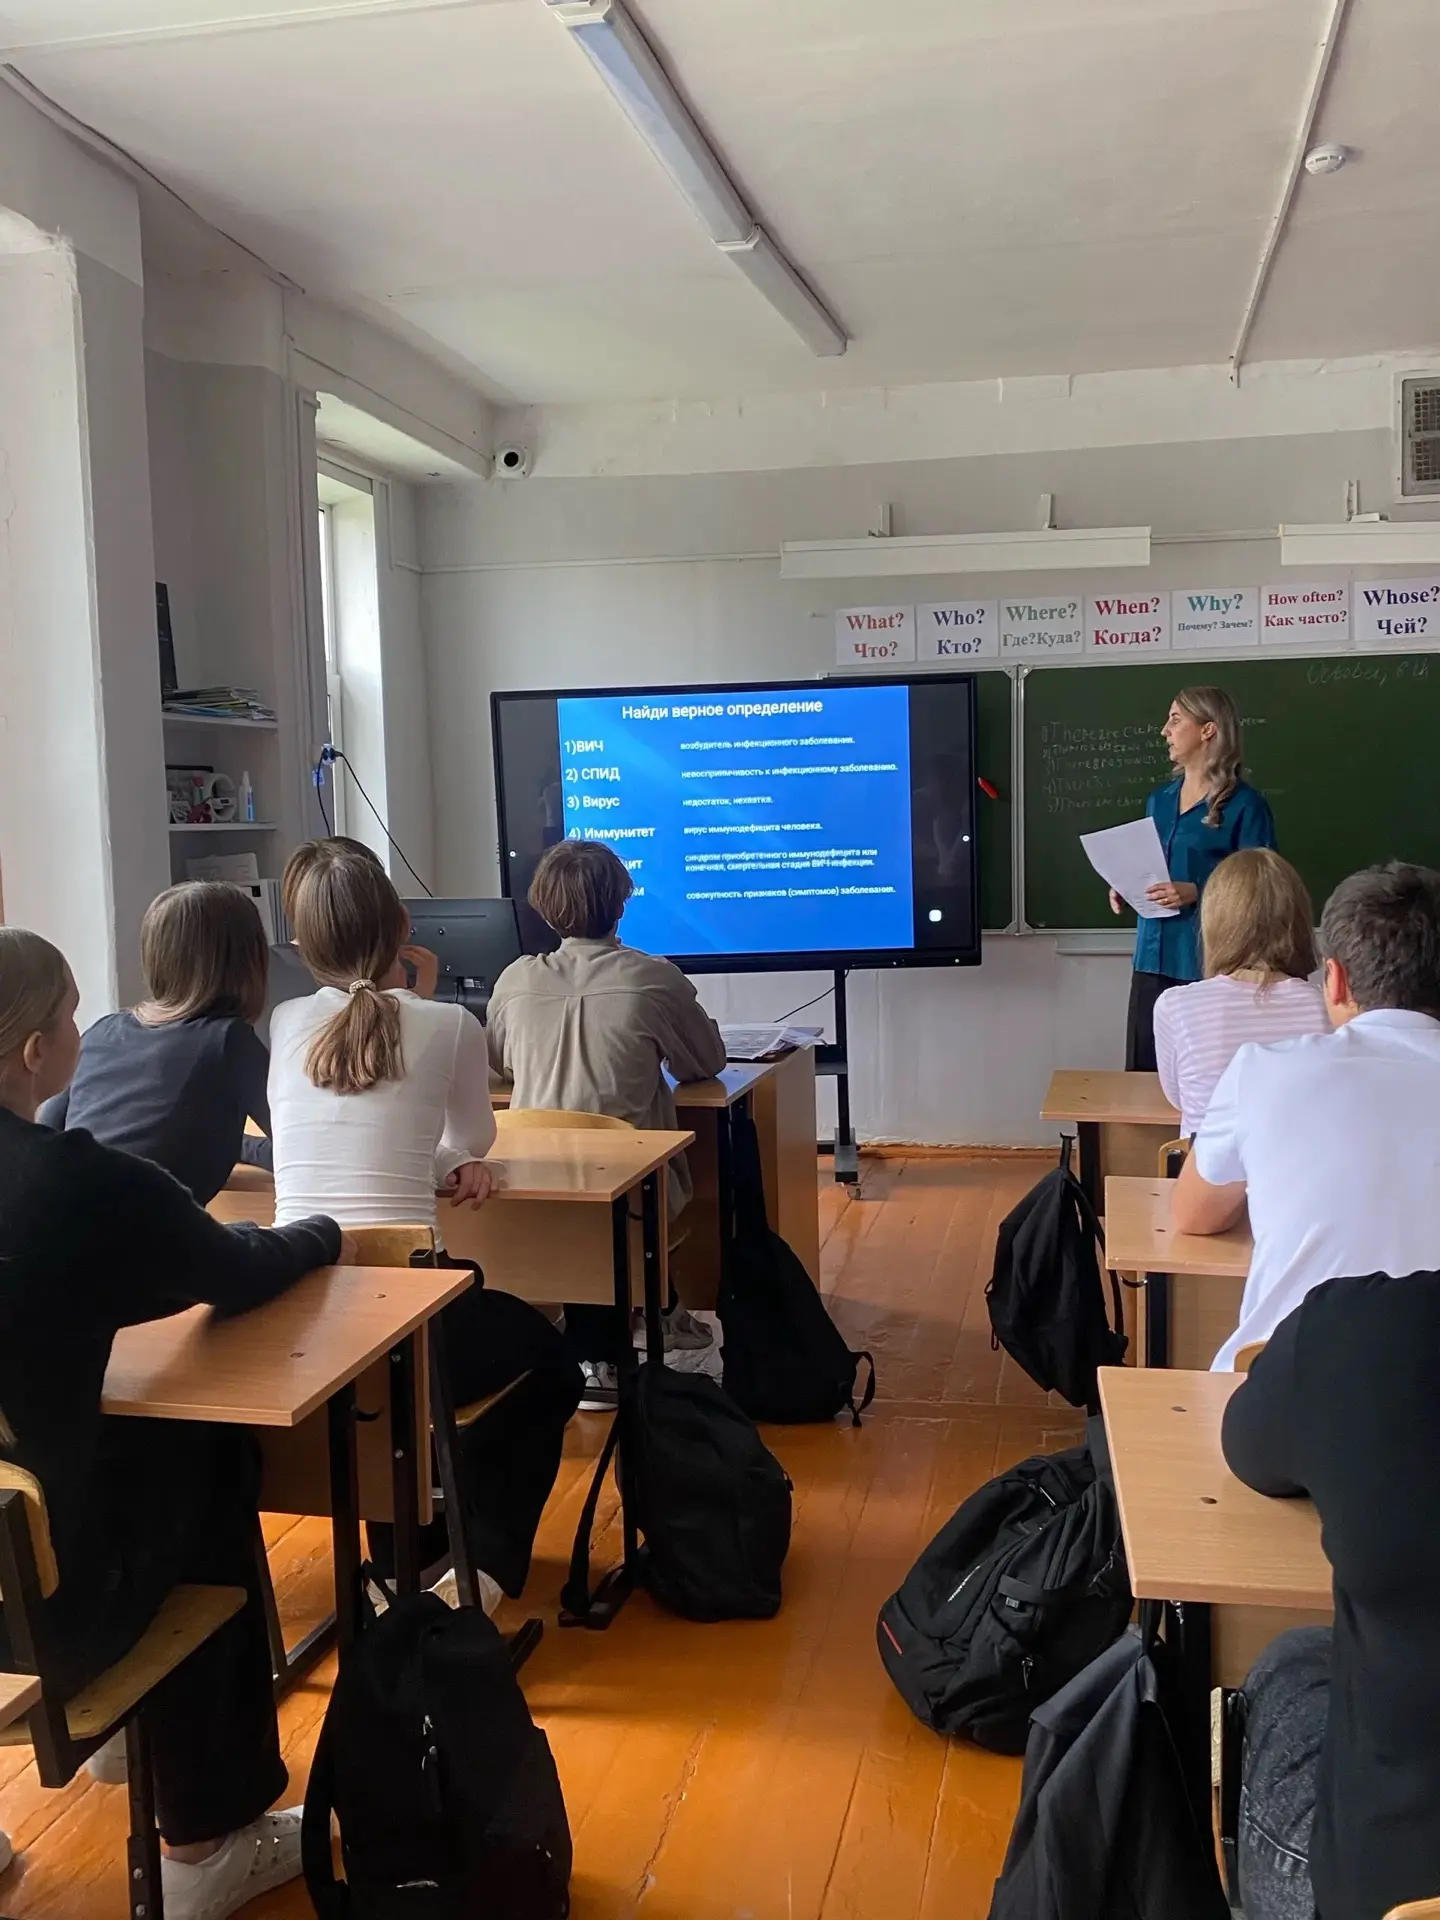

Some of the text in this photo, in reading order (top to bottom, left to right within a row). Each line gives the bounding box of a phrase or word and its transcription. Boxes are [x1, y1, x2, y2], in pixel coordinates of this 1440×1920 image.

[1188, 594, 1243, 614] Why?
[1268, 589, 1344, 605] How often?
[1363, 586, 1440, 606] Whose?
[1006, 602, 1077, 621] Where?
[1094, 597, 1161, 616] When?
[846, 612, 904, 631] What?
[932, 608, 985, 627] Who?
[1178, 620, 1253, 631] Почему? Зачем?
[1264, 610, 1347, 628] Как часто?
[1376, 616, 1428, 636] Чей?
[1093, 626, 1162, 645] Когда?
[854, 641, 898, 658] Что?
[936, 637, 982, 656] Кто?
[622, 700, 823, 721] Найди верное определение
[564, 740, 604, 755] 1)ВИЧ
[680, 742, 732, 751] возбудитель
[733, 738, 798, 749] инфекционного
[565, 767, 621, 783] 2) СПИД
[566, 795, 620, 810] 3) Вирус
[568, 827, 655, 840] 4) Иммунитет
